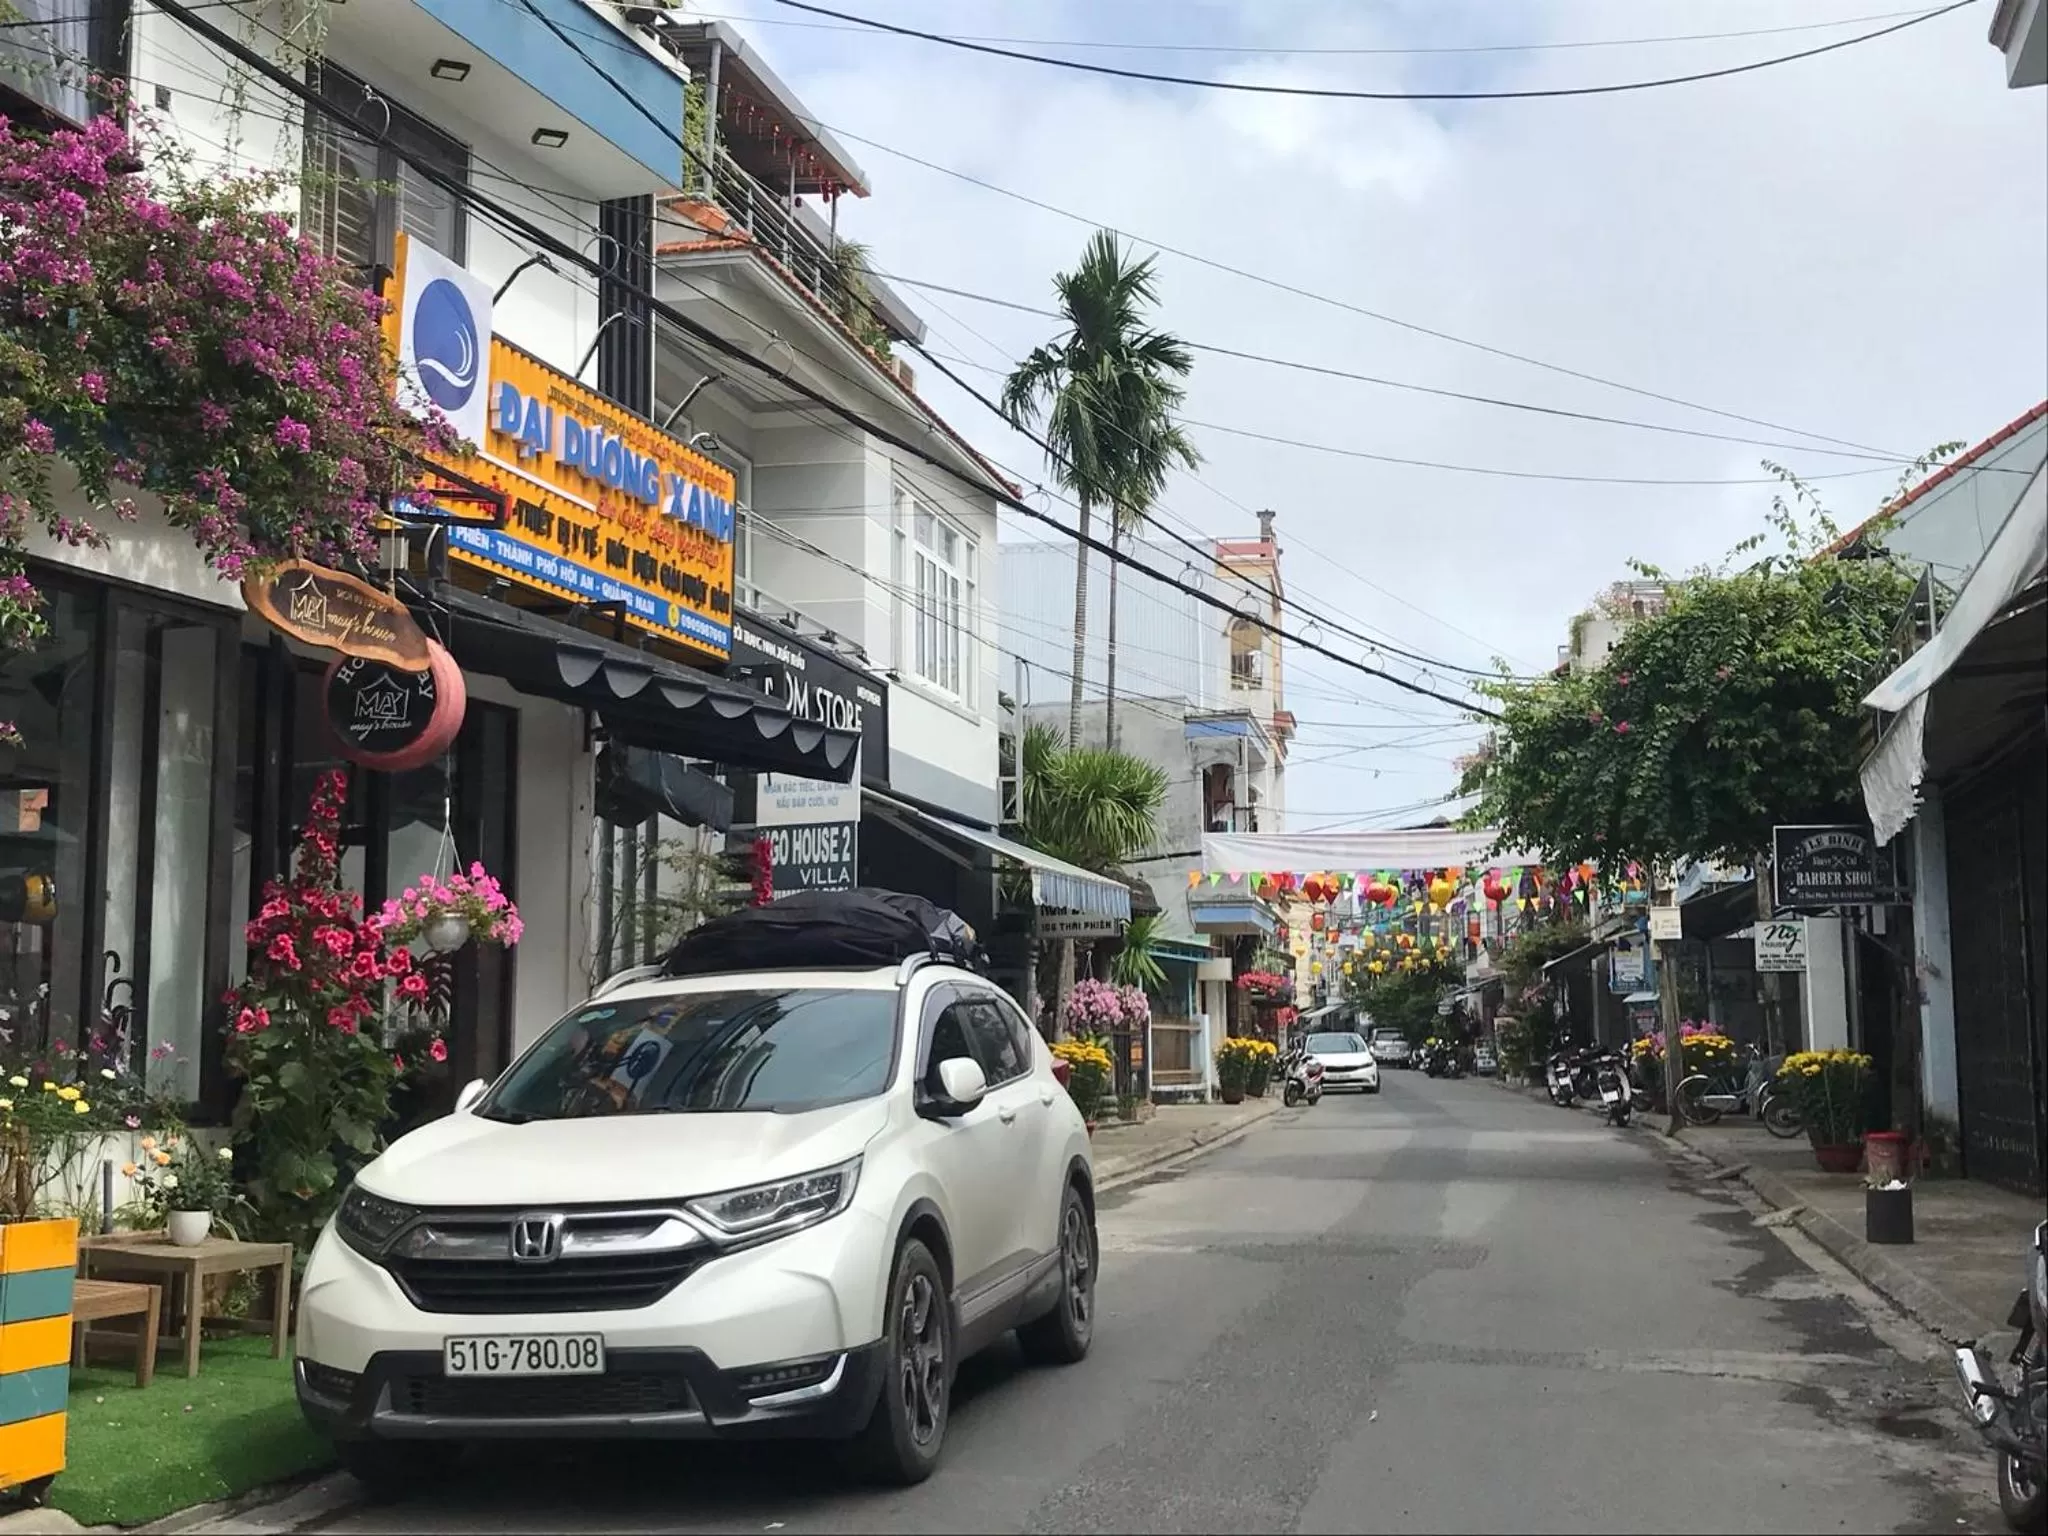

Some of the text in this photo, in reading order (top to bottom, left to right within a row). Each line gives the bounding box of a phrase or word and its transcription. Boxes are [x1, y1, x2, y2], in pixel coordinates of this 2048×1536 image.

[490, 381, 553, 458] ĐẠI
[662, 472, 735, 544] XANH
[571, 521, 581, 553] Y
[497, 540, 533, 567] THÀNH
[536, 555, 558, 578] PHỐ
[561, 564, 578, 588] HỘI
[580, 573, 595, 591] AN
[815, 686, 863, 733] STORE
[792, 827, 839, 865] HOUSE
[841, 825, 852, 862] 2
[800, 866, 850, 885] VILLA
[1796, 871, 1842, 886] BARBER
[450, 1338, 599, 1372] 51G-780.08
